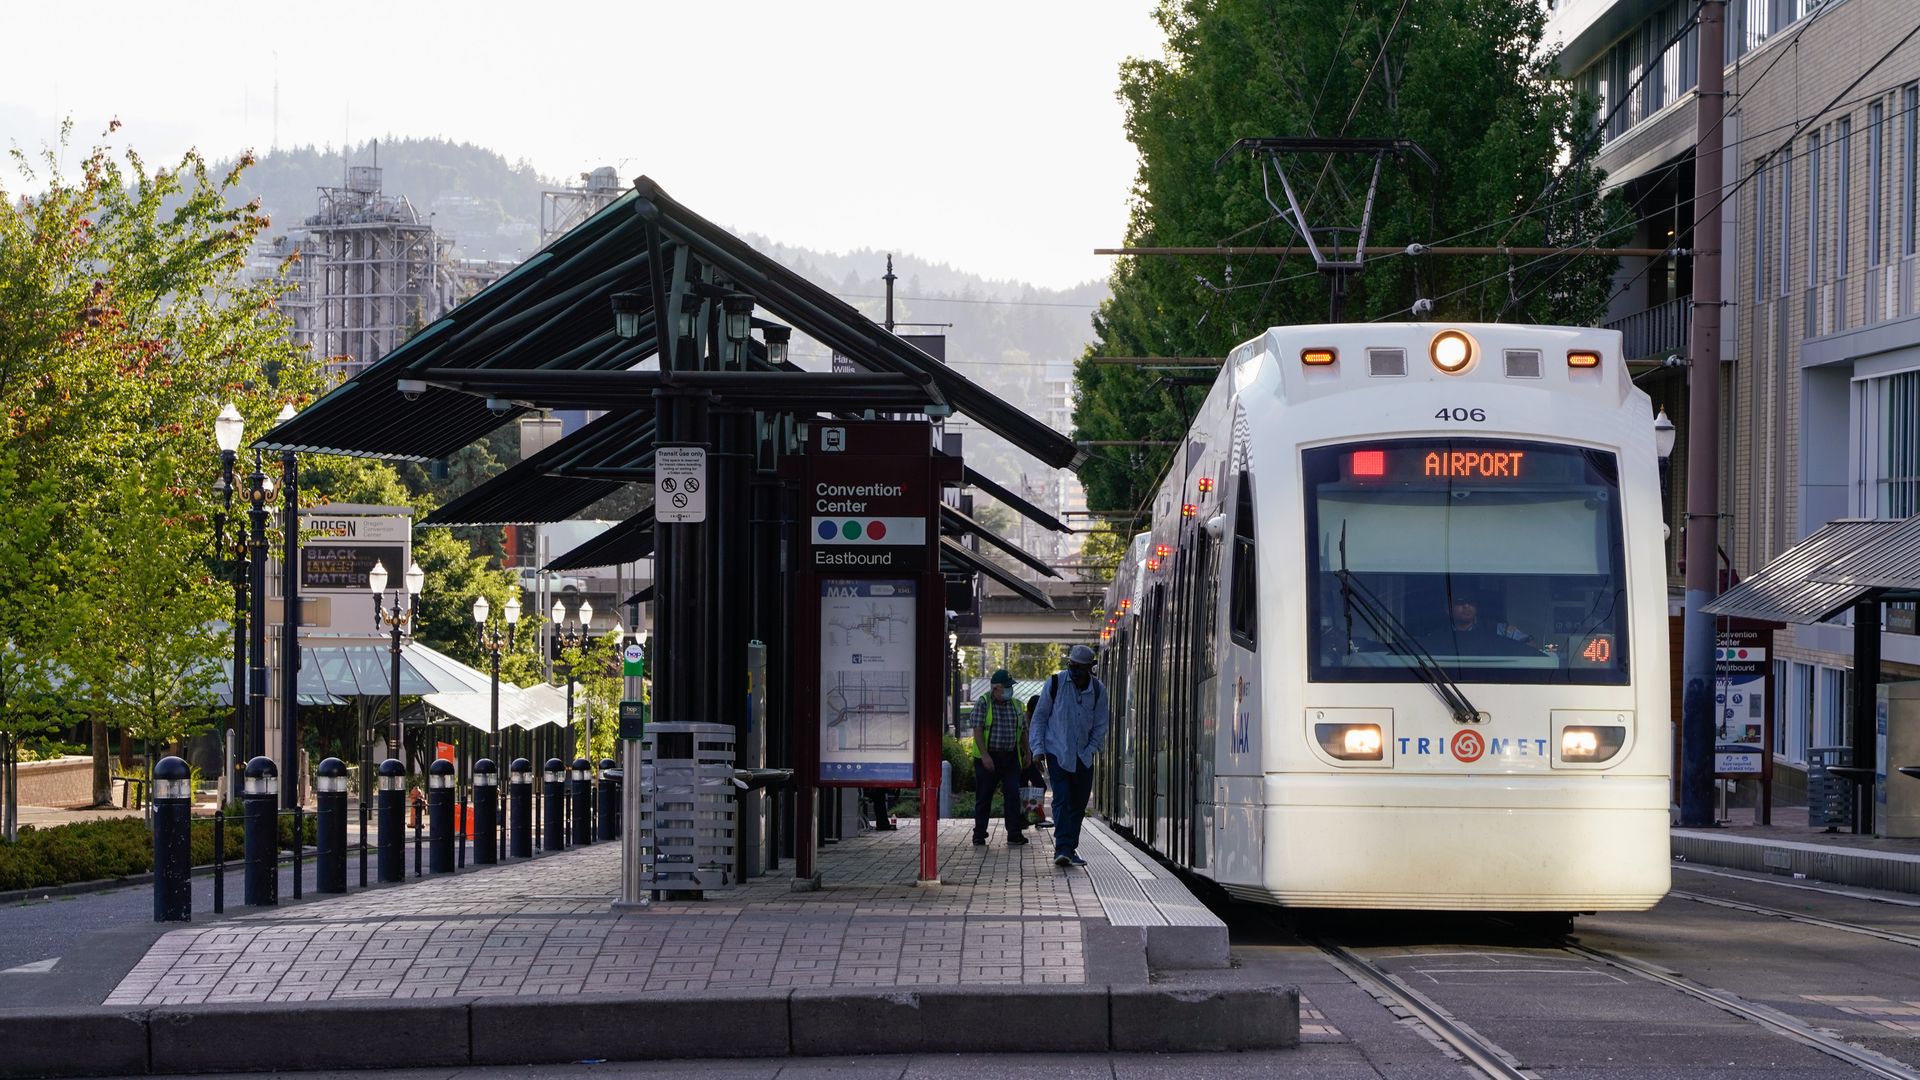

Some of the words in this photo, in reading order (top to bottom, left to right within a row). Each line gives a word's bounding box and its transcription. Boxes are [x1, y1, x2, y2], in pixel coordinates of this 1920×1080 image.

[833, 365, 856, 374] Willis
[1434, 407, 1487, 422] 406
[690, 450, 704, 458] only
[1424, 451, 1524, 477] AIRPORT
[816, 482, 902, 497] Convention
[816, 499, 868, 512] Center
[307, 549, 357, 560] BLACK
[815, 551, 892, 565] Eastbound
[307, 573, 368, 584] MATTER
[827, 586, 859, 598] MAX
[1583, 638, 1610, 662] 40
[1397, 737, 1445, 755] TRI
[1490, 737, 1547, 756] MET
